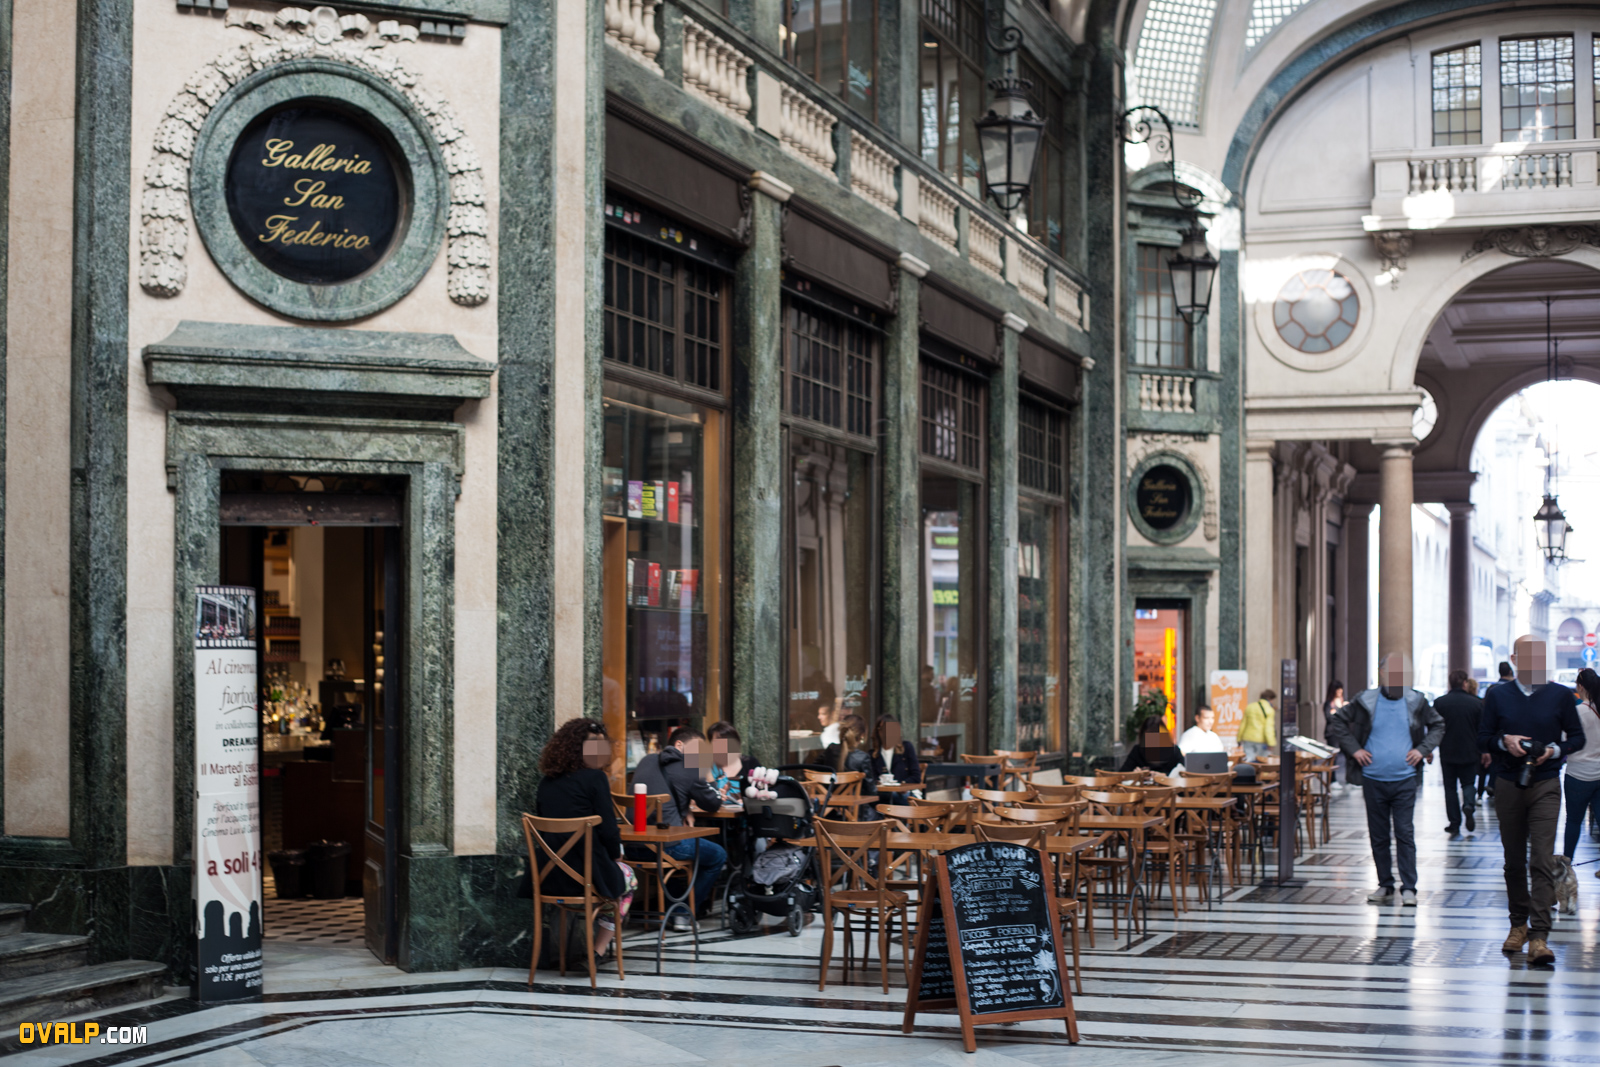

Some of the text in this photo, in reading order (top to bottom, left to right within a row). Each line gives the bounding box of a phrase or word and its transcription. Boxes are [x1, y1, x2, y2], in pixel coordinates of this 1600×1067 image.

[262, 138, 372, 175] Galleria
[284, 178, 345, 210] San
[258, 215, 371, 250] Federico
[206, 658, 222, 675] Al
[1216, 702, 1243, 724] 20%
[201, 763, 207, 775] Il
[234, 775, 241, 787] al
[207, 859, 218, 876] a
[223, 850, 250, 875] soli
[951, 845, 1027, 866] HAPPY HOUR
[997, 926, 1033, 937] PORZIONI
